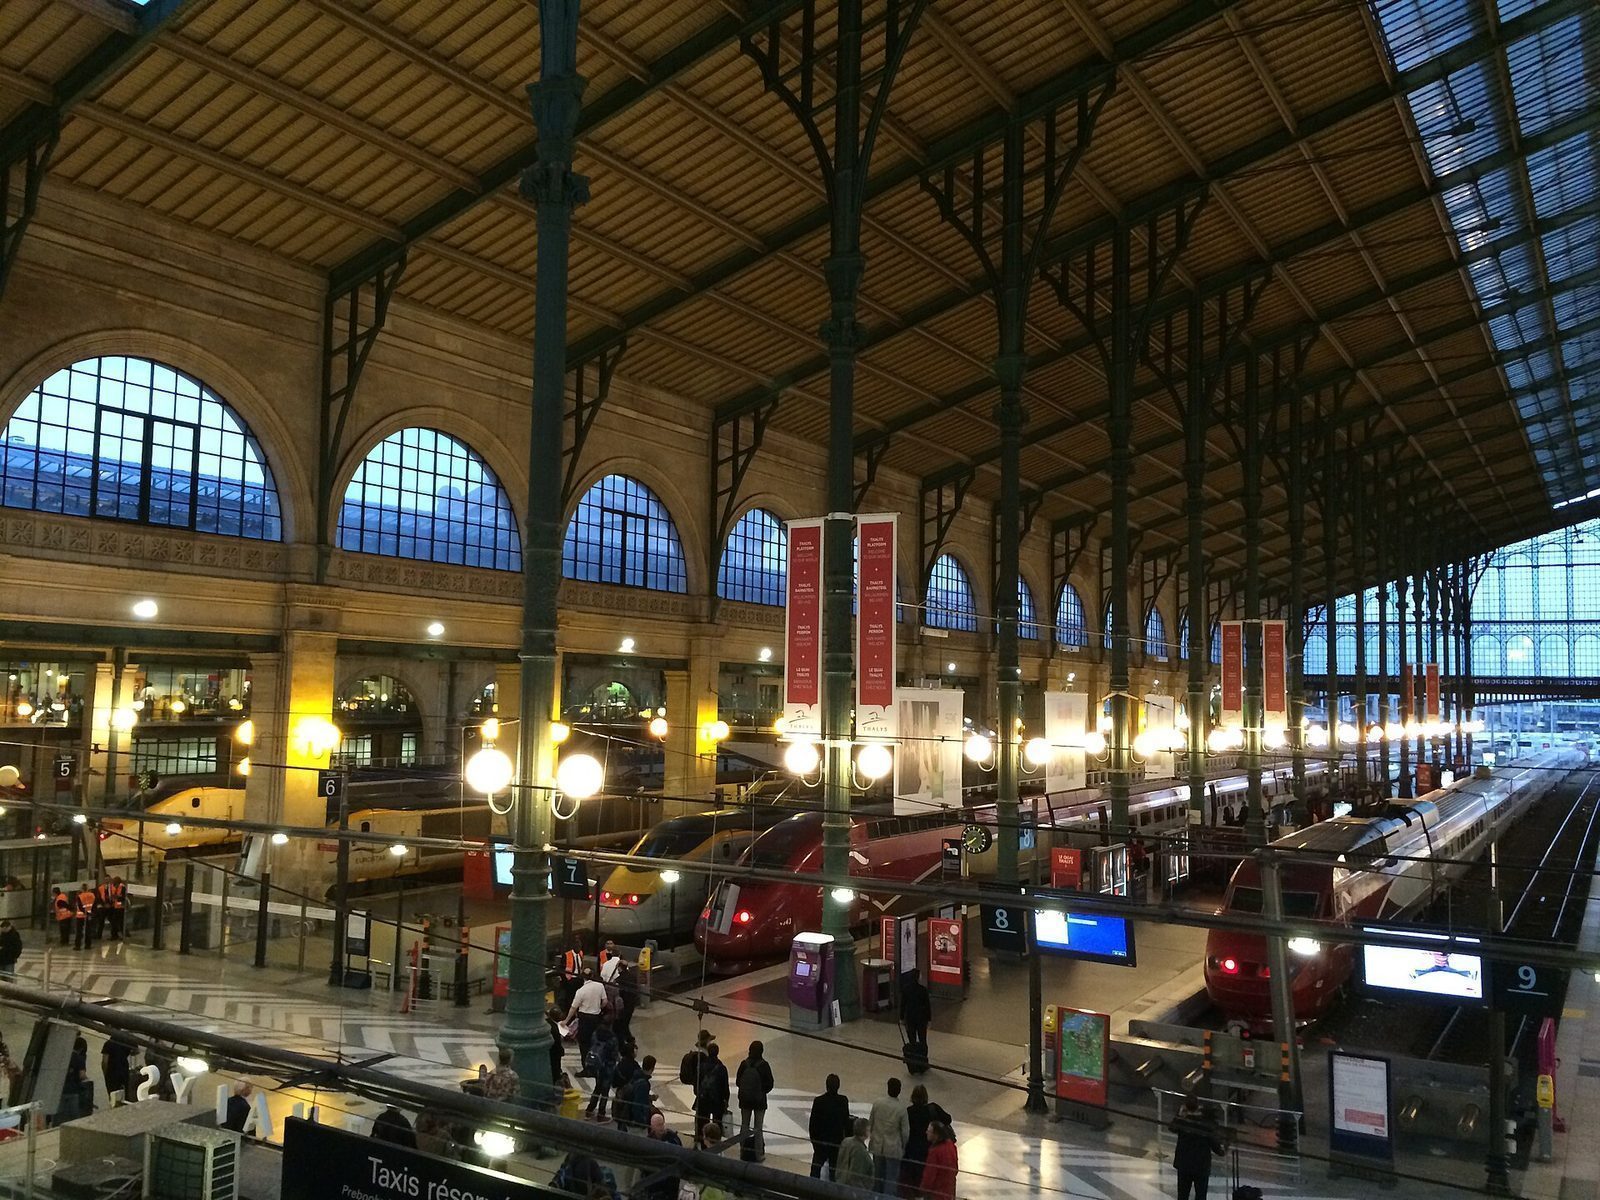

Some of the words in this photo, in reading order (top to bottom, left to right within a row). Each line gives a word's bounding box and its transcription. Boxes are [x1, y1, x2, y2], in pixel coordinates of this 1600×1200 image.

[60, 762, 70, 776] 5
[326, 779, 336, 796] 6
[566, 865, 577, 882] 7
[995, 908, 1009, 929] 8
[1518, 965, 1537, 990] 9
[367, 1156, 420, 1197] Taxis
